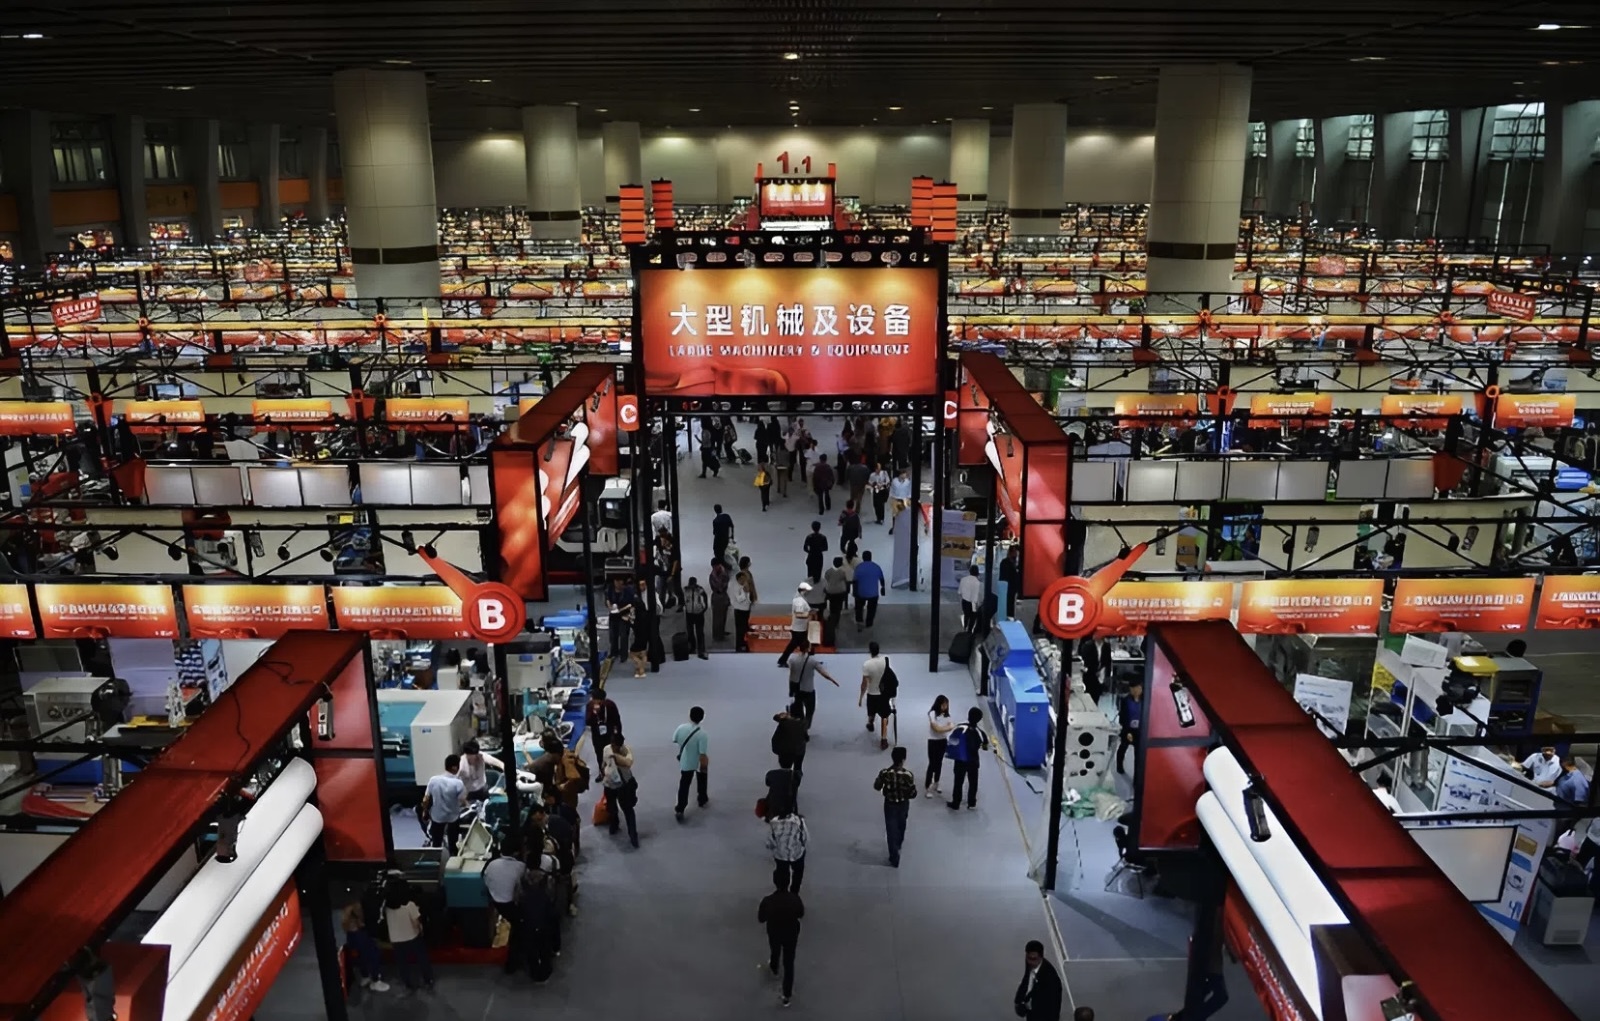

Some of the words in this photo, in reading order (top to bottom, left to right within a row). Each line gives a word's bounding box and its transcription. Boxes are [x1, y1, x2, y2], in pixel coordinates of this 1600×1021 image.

[777, 151, 811, 174] 1.1
[669, 303, 911, 336] 大型机械及设备
[620, 404, 637, 424] C
[478, 598, 506, 630] B
[1057, 593, 1084, 625] B
